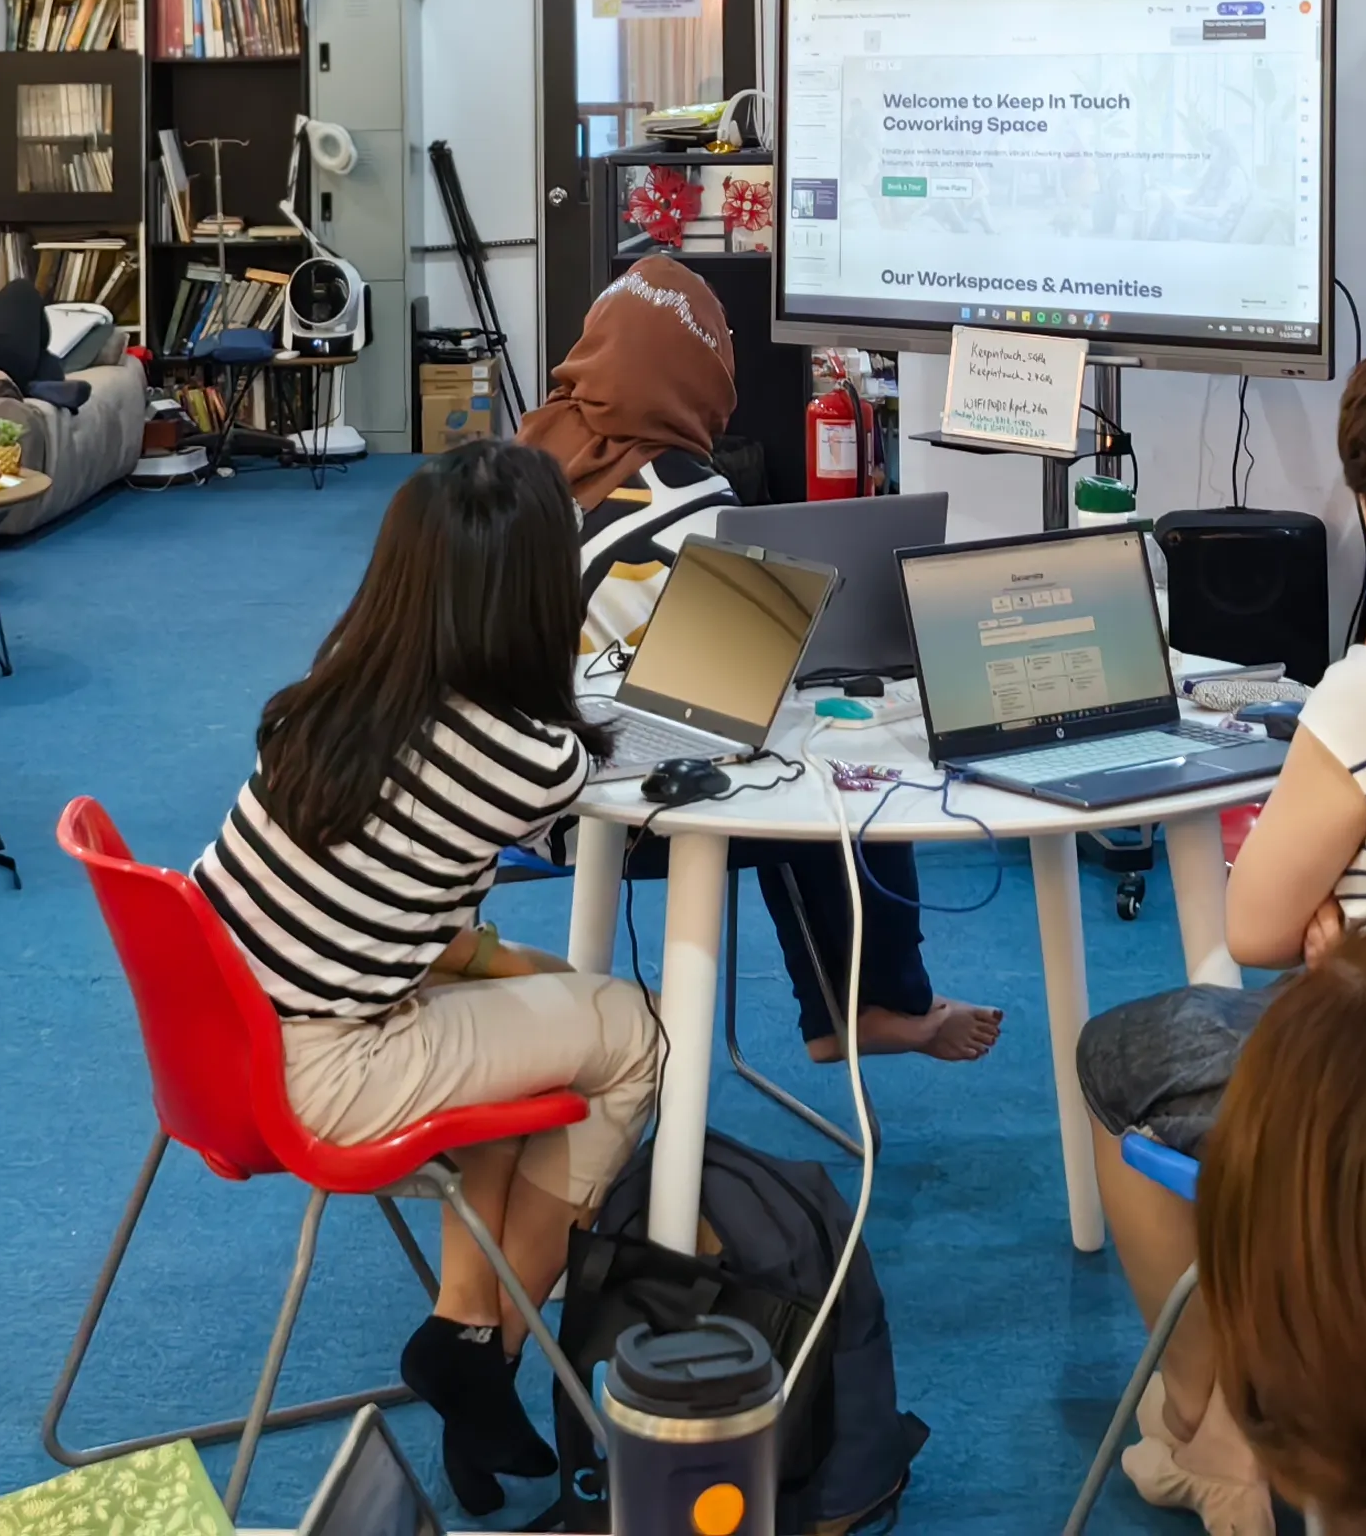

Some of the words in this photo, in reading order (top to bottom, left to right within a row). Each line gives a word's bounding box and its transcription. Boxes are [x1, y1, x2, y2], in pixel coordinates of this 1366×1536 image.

[882, 93, 969, 110] Welcome
[972, 94, 993, 110] to
[997, 93, 1045, 112] Keep
[1048, 93, 1066, 109] In
[1069, 93, 1131, 110] Touch
[882, 115, 983, 135] Coworking
[987, 116, 1048, 135] Space
[881, 269, 915, 286] Our
[917, 270, 1038, 292] Workspaces
[1041, 276, 1057, 293] &
[1059, 277, 1163, 298] Amenities
